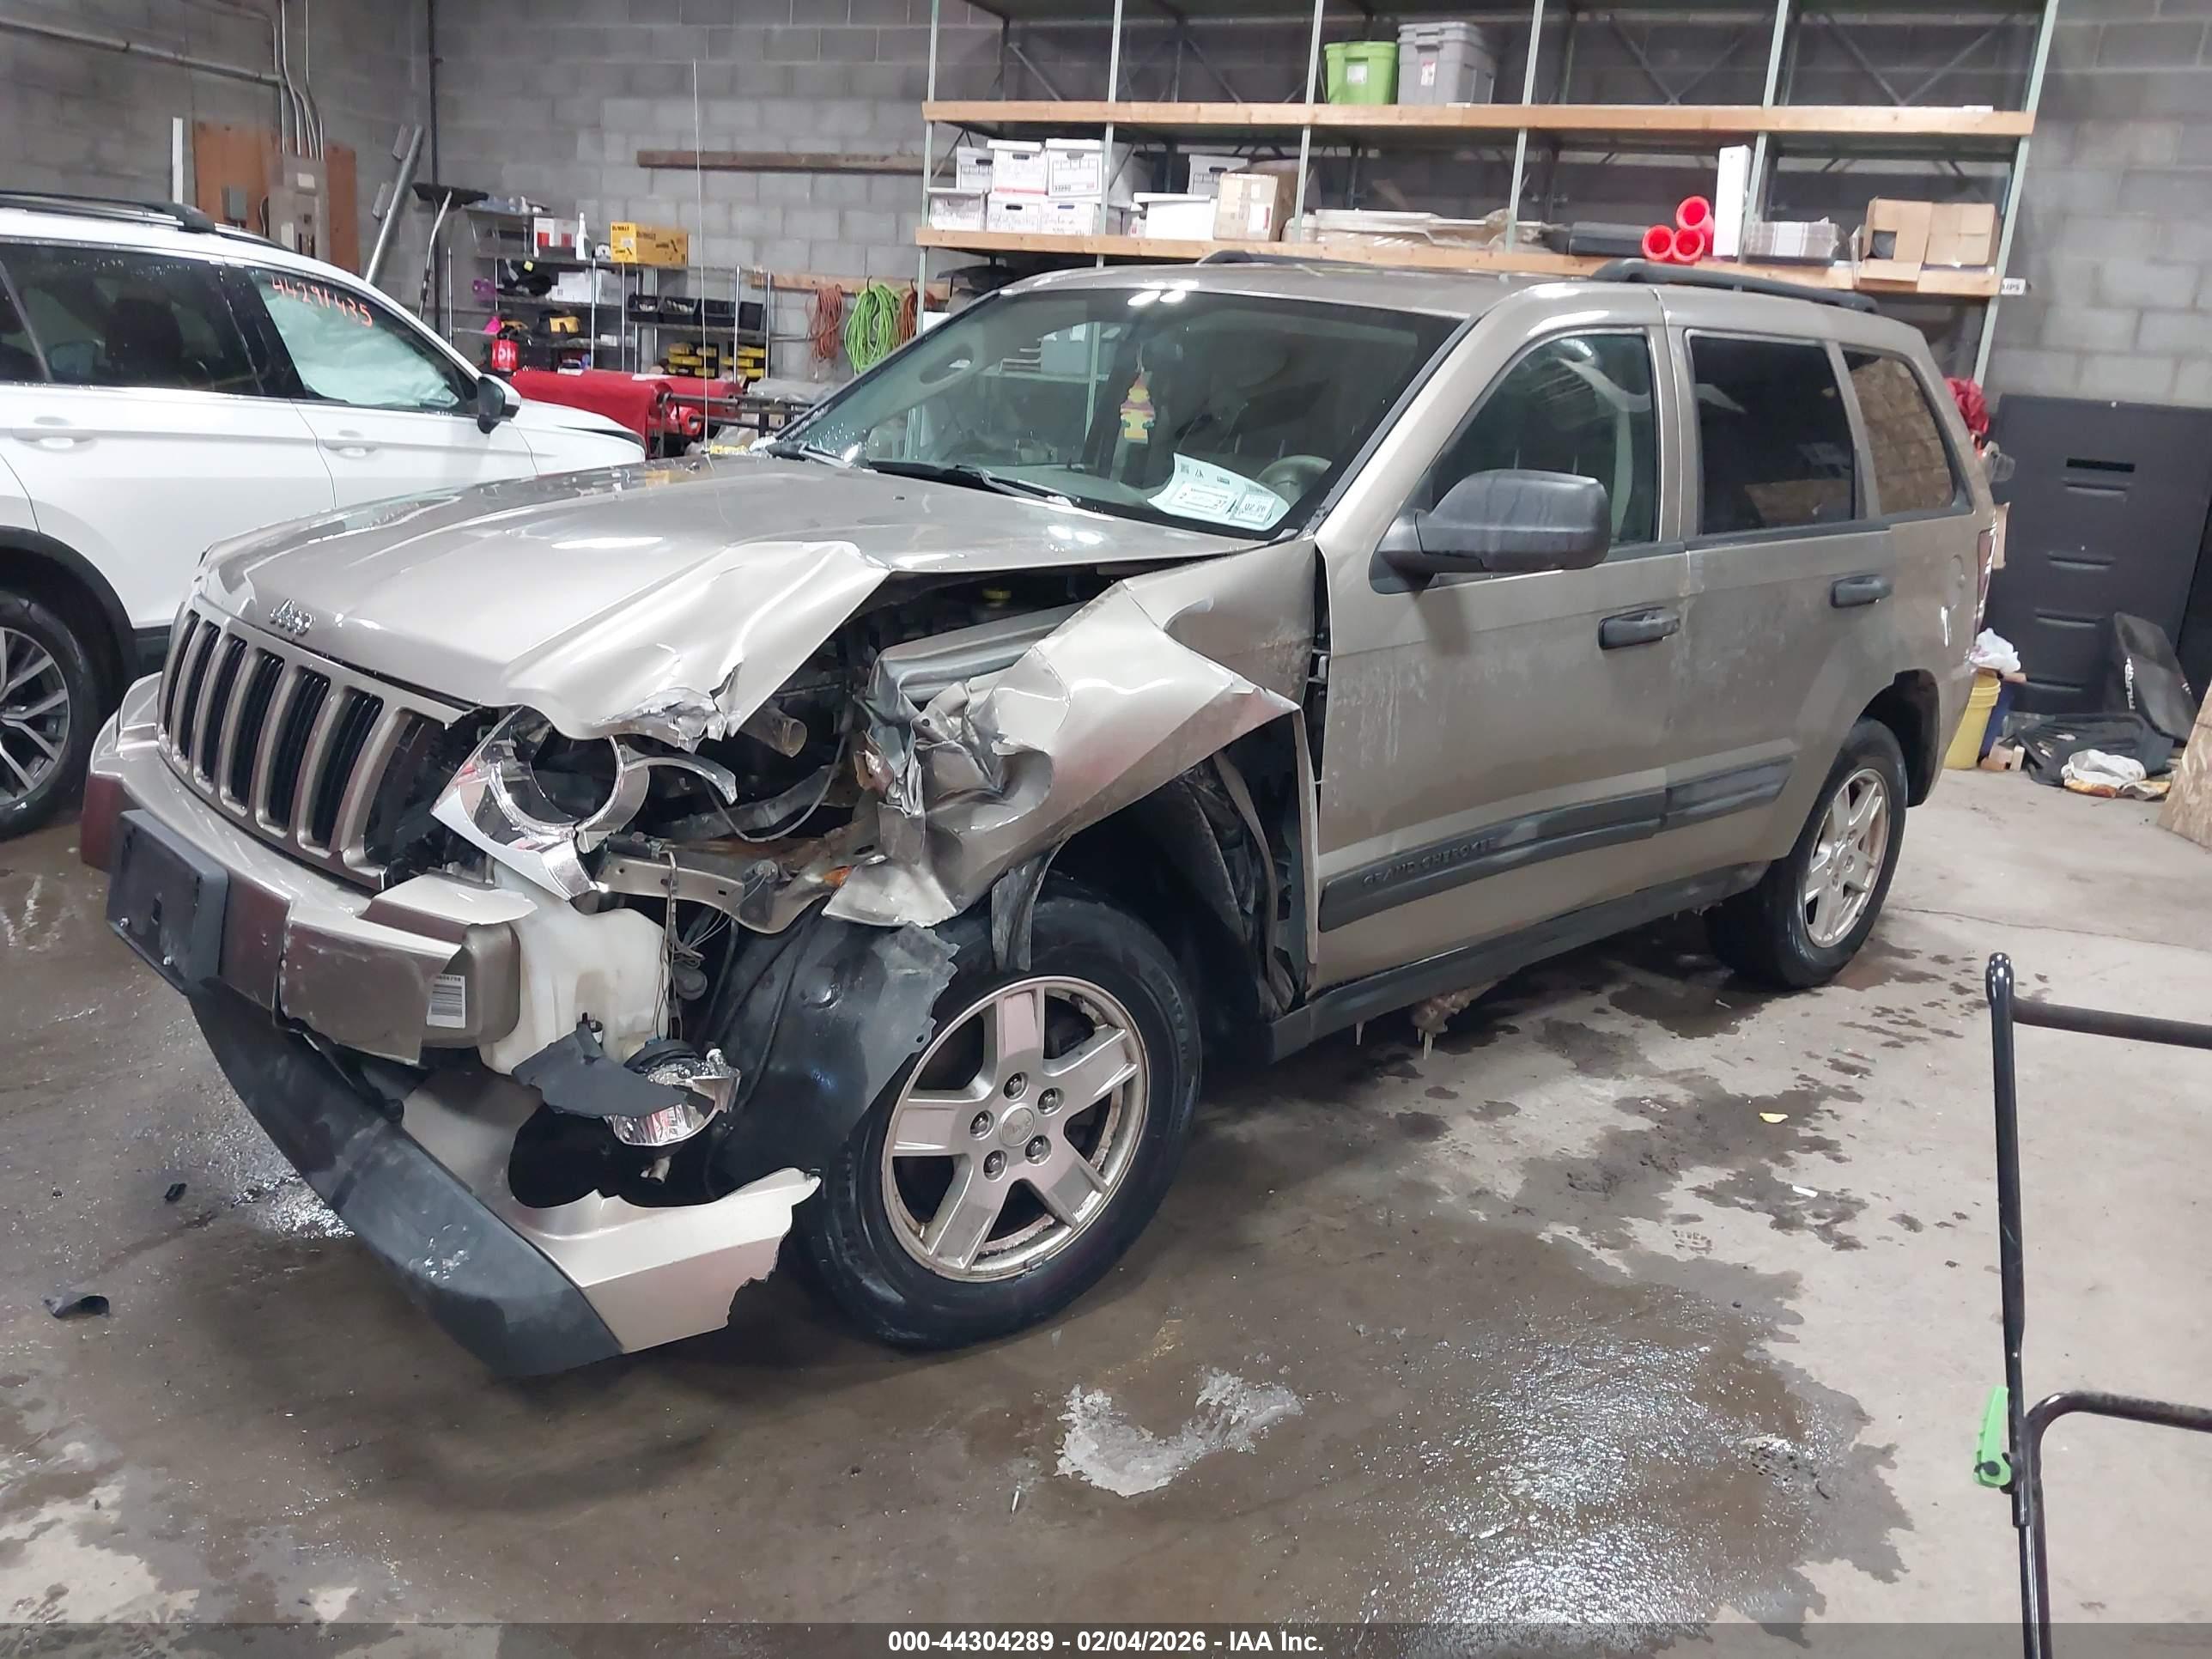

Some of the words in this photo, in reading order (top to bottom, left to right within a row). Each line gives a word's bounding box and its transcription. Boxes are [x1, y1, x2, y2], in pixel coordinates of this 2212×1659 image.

[269, 598, 315, 635] Jeep
[1361, 860, 1416, 886] GRAND
[1420, 836, 1497, 870] CHEROKEE
